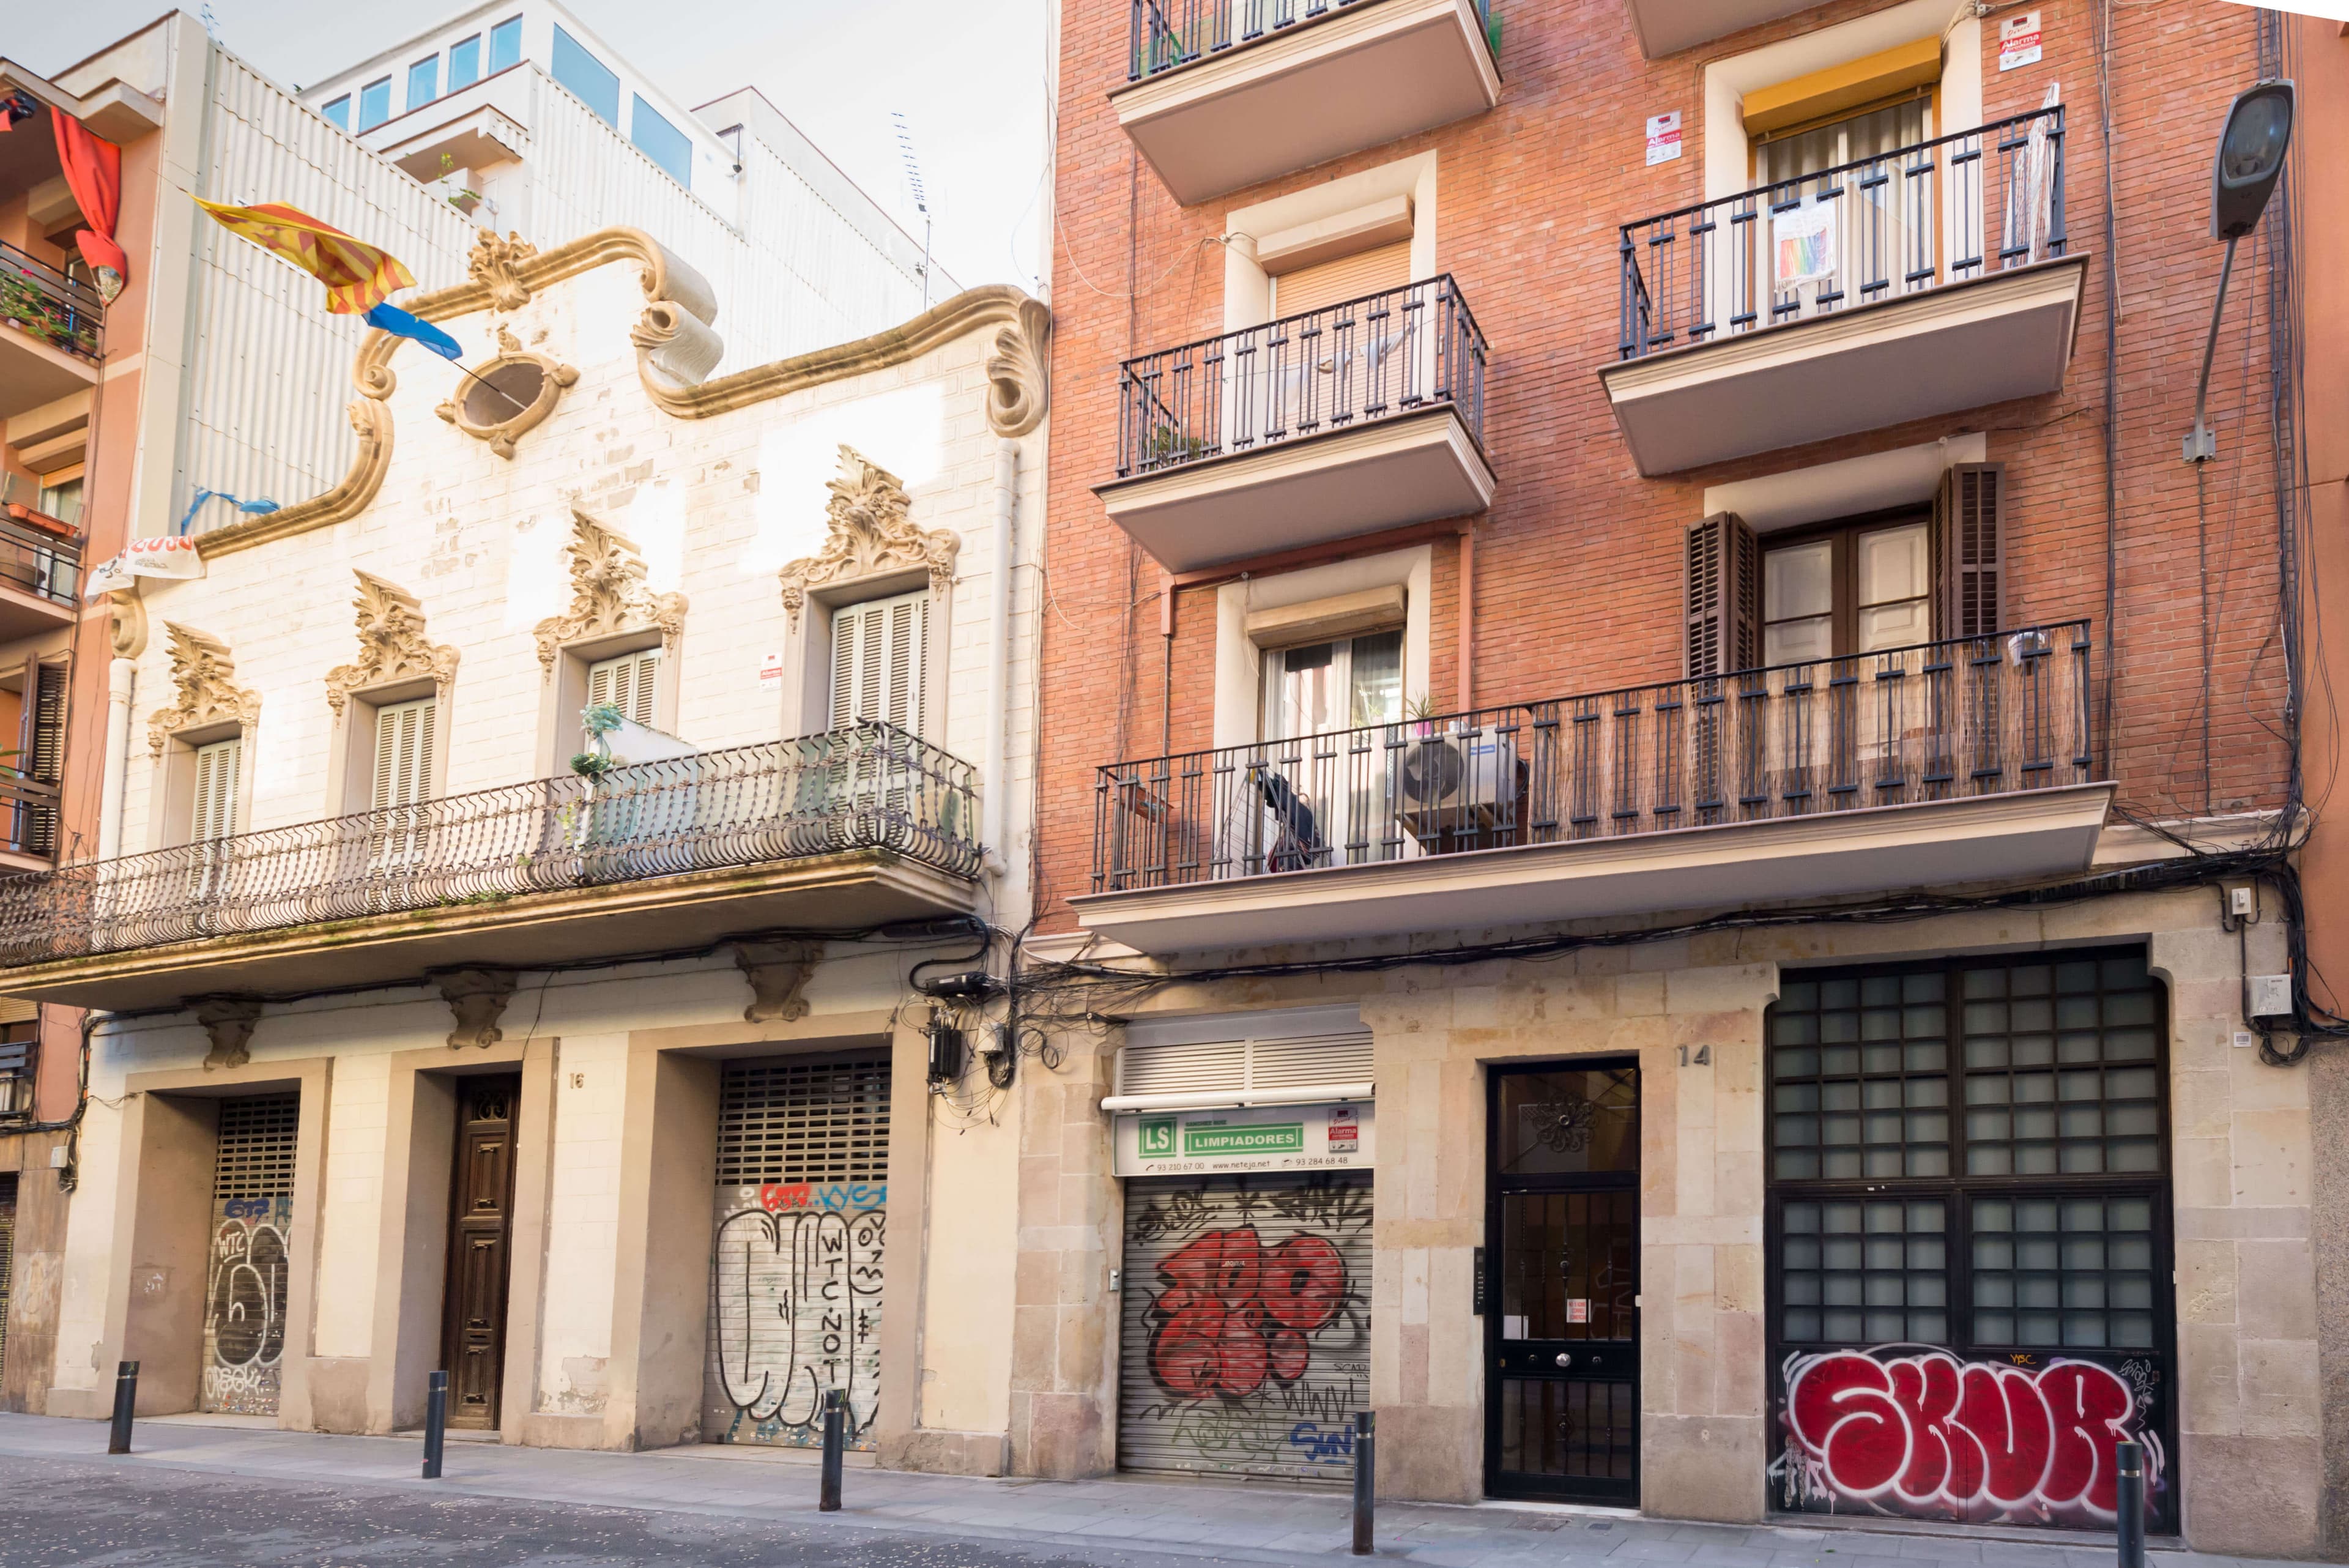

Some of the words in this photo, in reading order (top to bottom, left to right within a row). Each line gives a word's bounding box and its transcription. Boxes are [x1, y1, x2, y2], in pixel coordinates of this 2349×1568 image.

[2002, 34, 2039, 50] Alarma
[1648, 133, 1680, 146] Alarma
[1677, 1044, 1710, 1066] 14
[570, 1072, 584, 1089] 16
[1146, 1126, 1170, 1150] LS
[1195, 1134, 1295, 1148] LIMPIADORES
[1212, 1161, 1271, 1169] www.neteja.net
